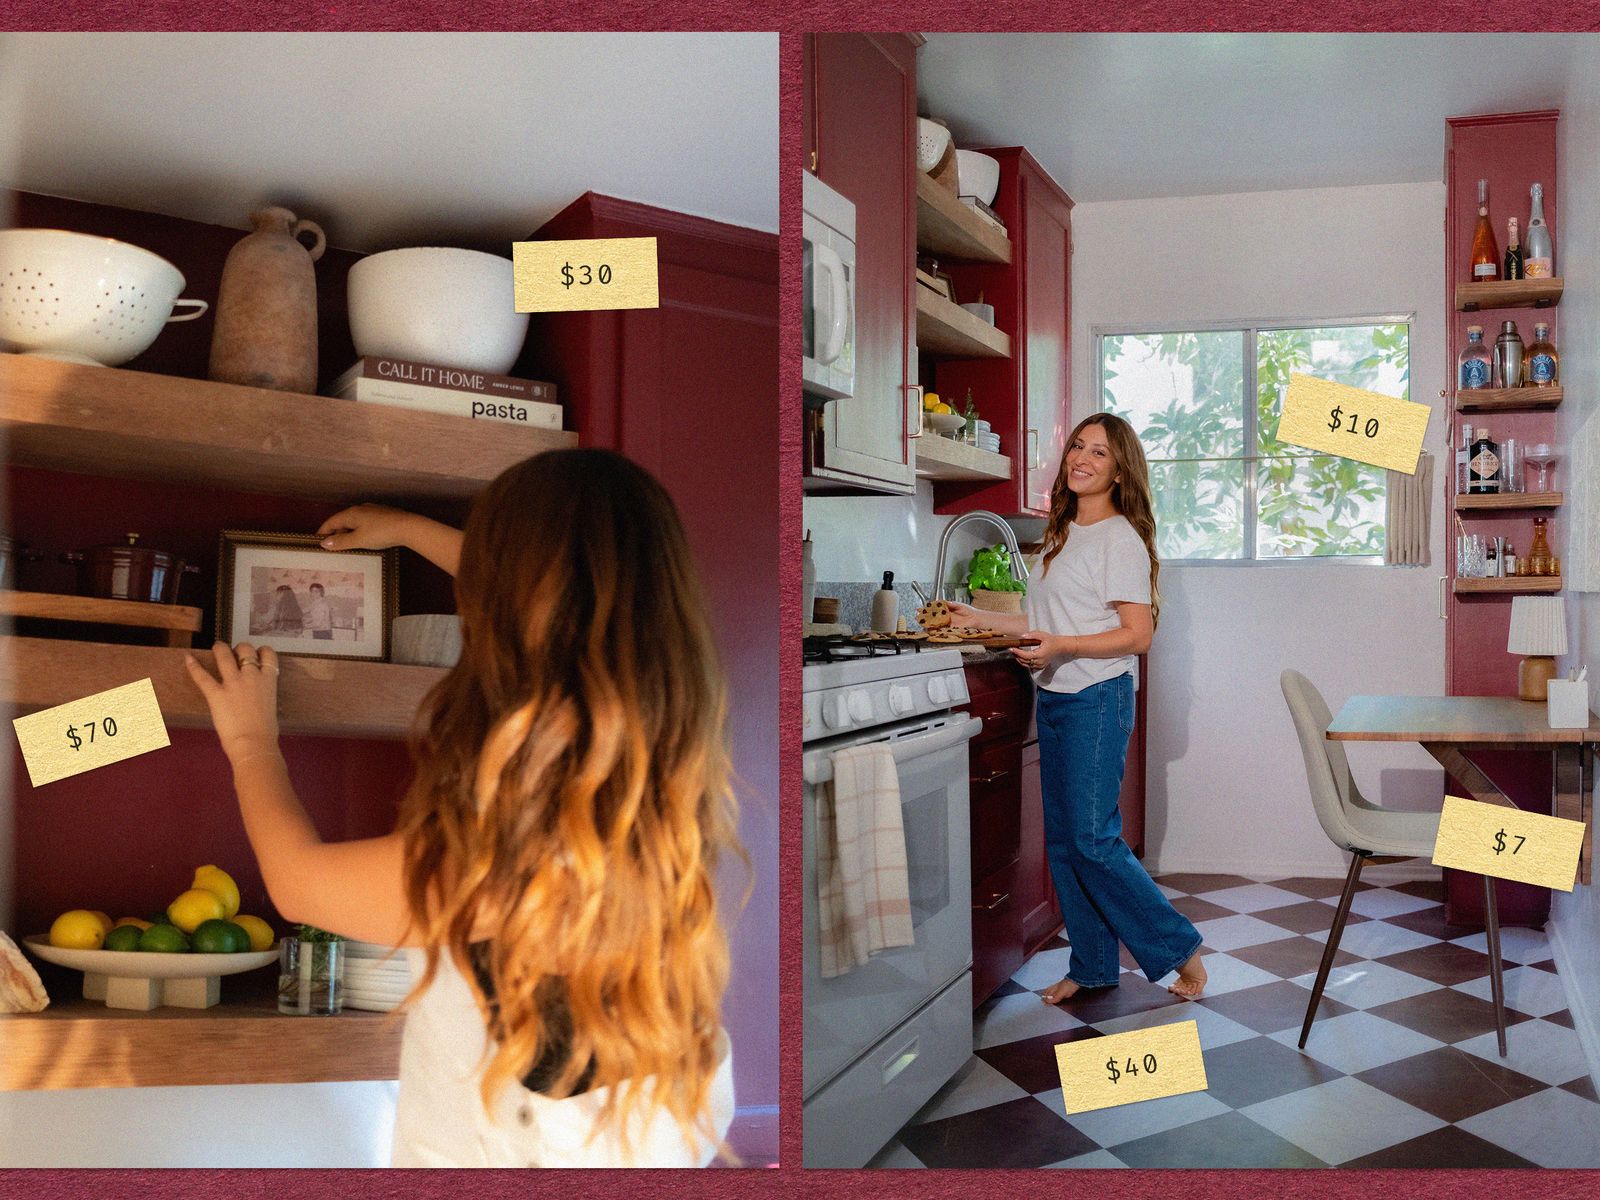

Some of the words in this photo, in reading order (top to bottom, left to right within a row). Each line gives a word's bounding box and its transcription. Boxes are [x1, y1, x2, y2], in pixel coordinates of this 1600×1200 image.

[377, 361, 418, 380] CALL
[421, 367, 436, 383] IT
[439, 370, 485, 390] HOME
[471, 401, 528, 422] pasta
